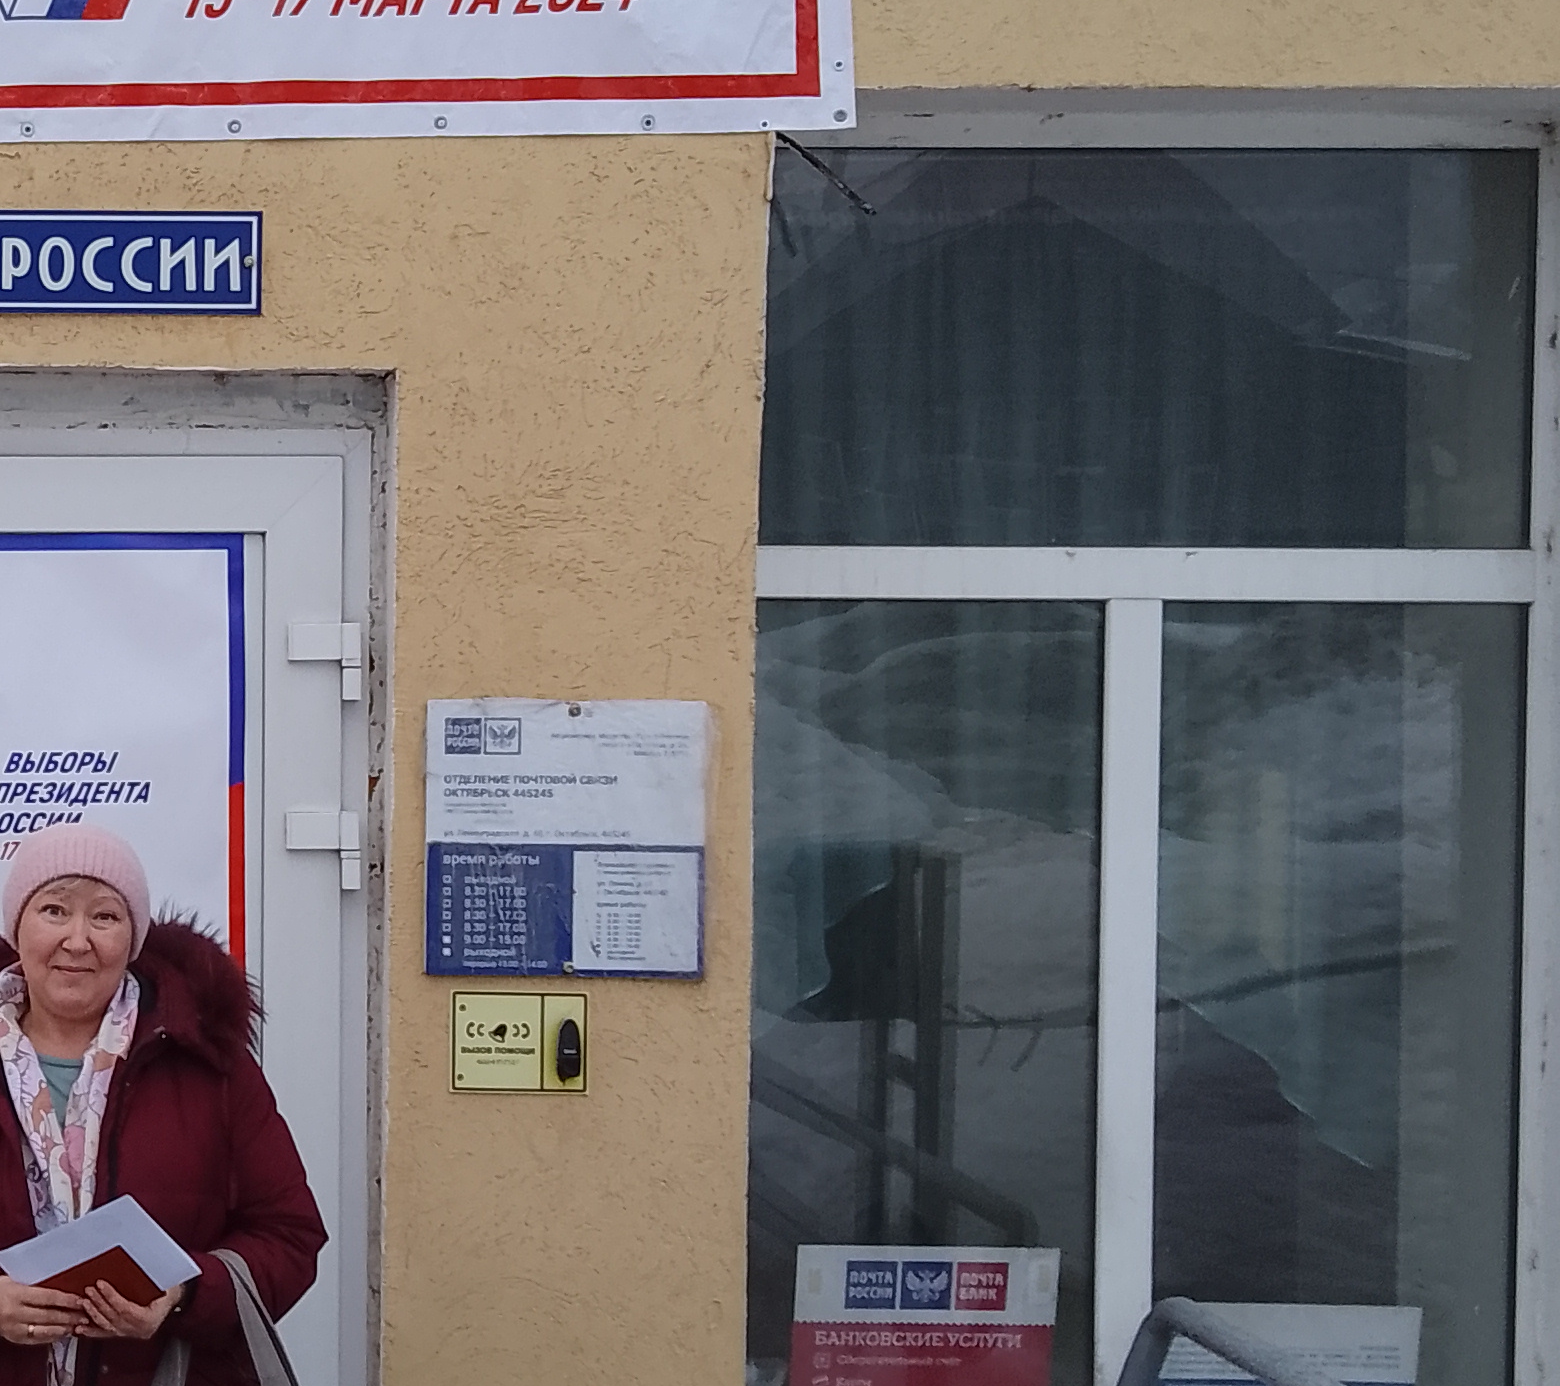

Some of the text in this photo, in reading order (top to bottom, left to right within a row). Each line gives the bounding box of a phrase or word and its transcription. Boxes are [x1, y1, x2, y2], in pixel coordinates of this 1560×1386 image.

[0, 236, 242, 292] РОССИИ
[3, 751, 119, 774] ВЫБОРЫ
[444, 774, 511, 786] ОТДЕЛЕНИЕ
[513, 773, 577, 786] ПОЧТОВОЙ
[443, 853, 540, 867] время работы
[849, 1270, 893, 1285] ПОЧТА
[960, 1272, 1004, 1287] ПОЧТА
[848, 1287, 893, 1300] РОССИИ
[959, 1288, 997, 1301] БАНК
[815, 1330, 1022, 1348] БАНКОВСКИЕ УСЛУГИ
